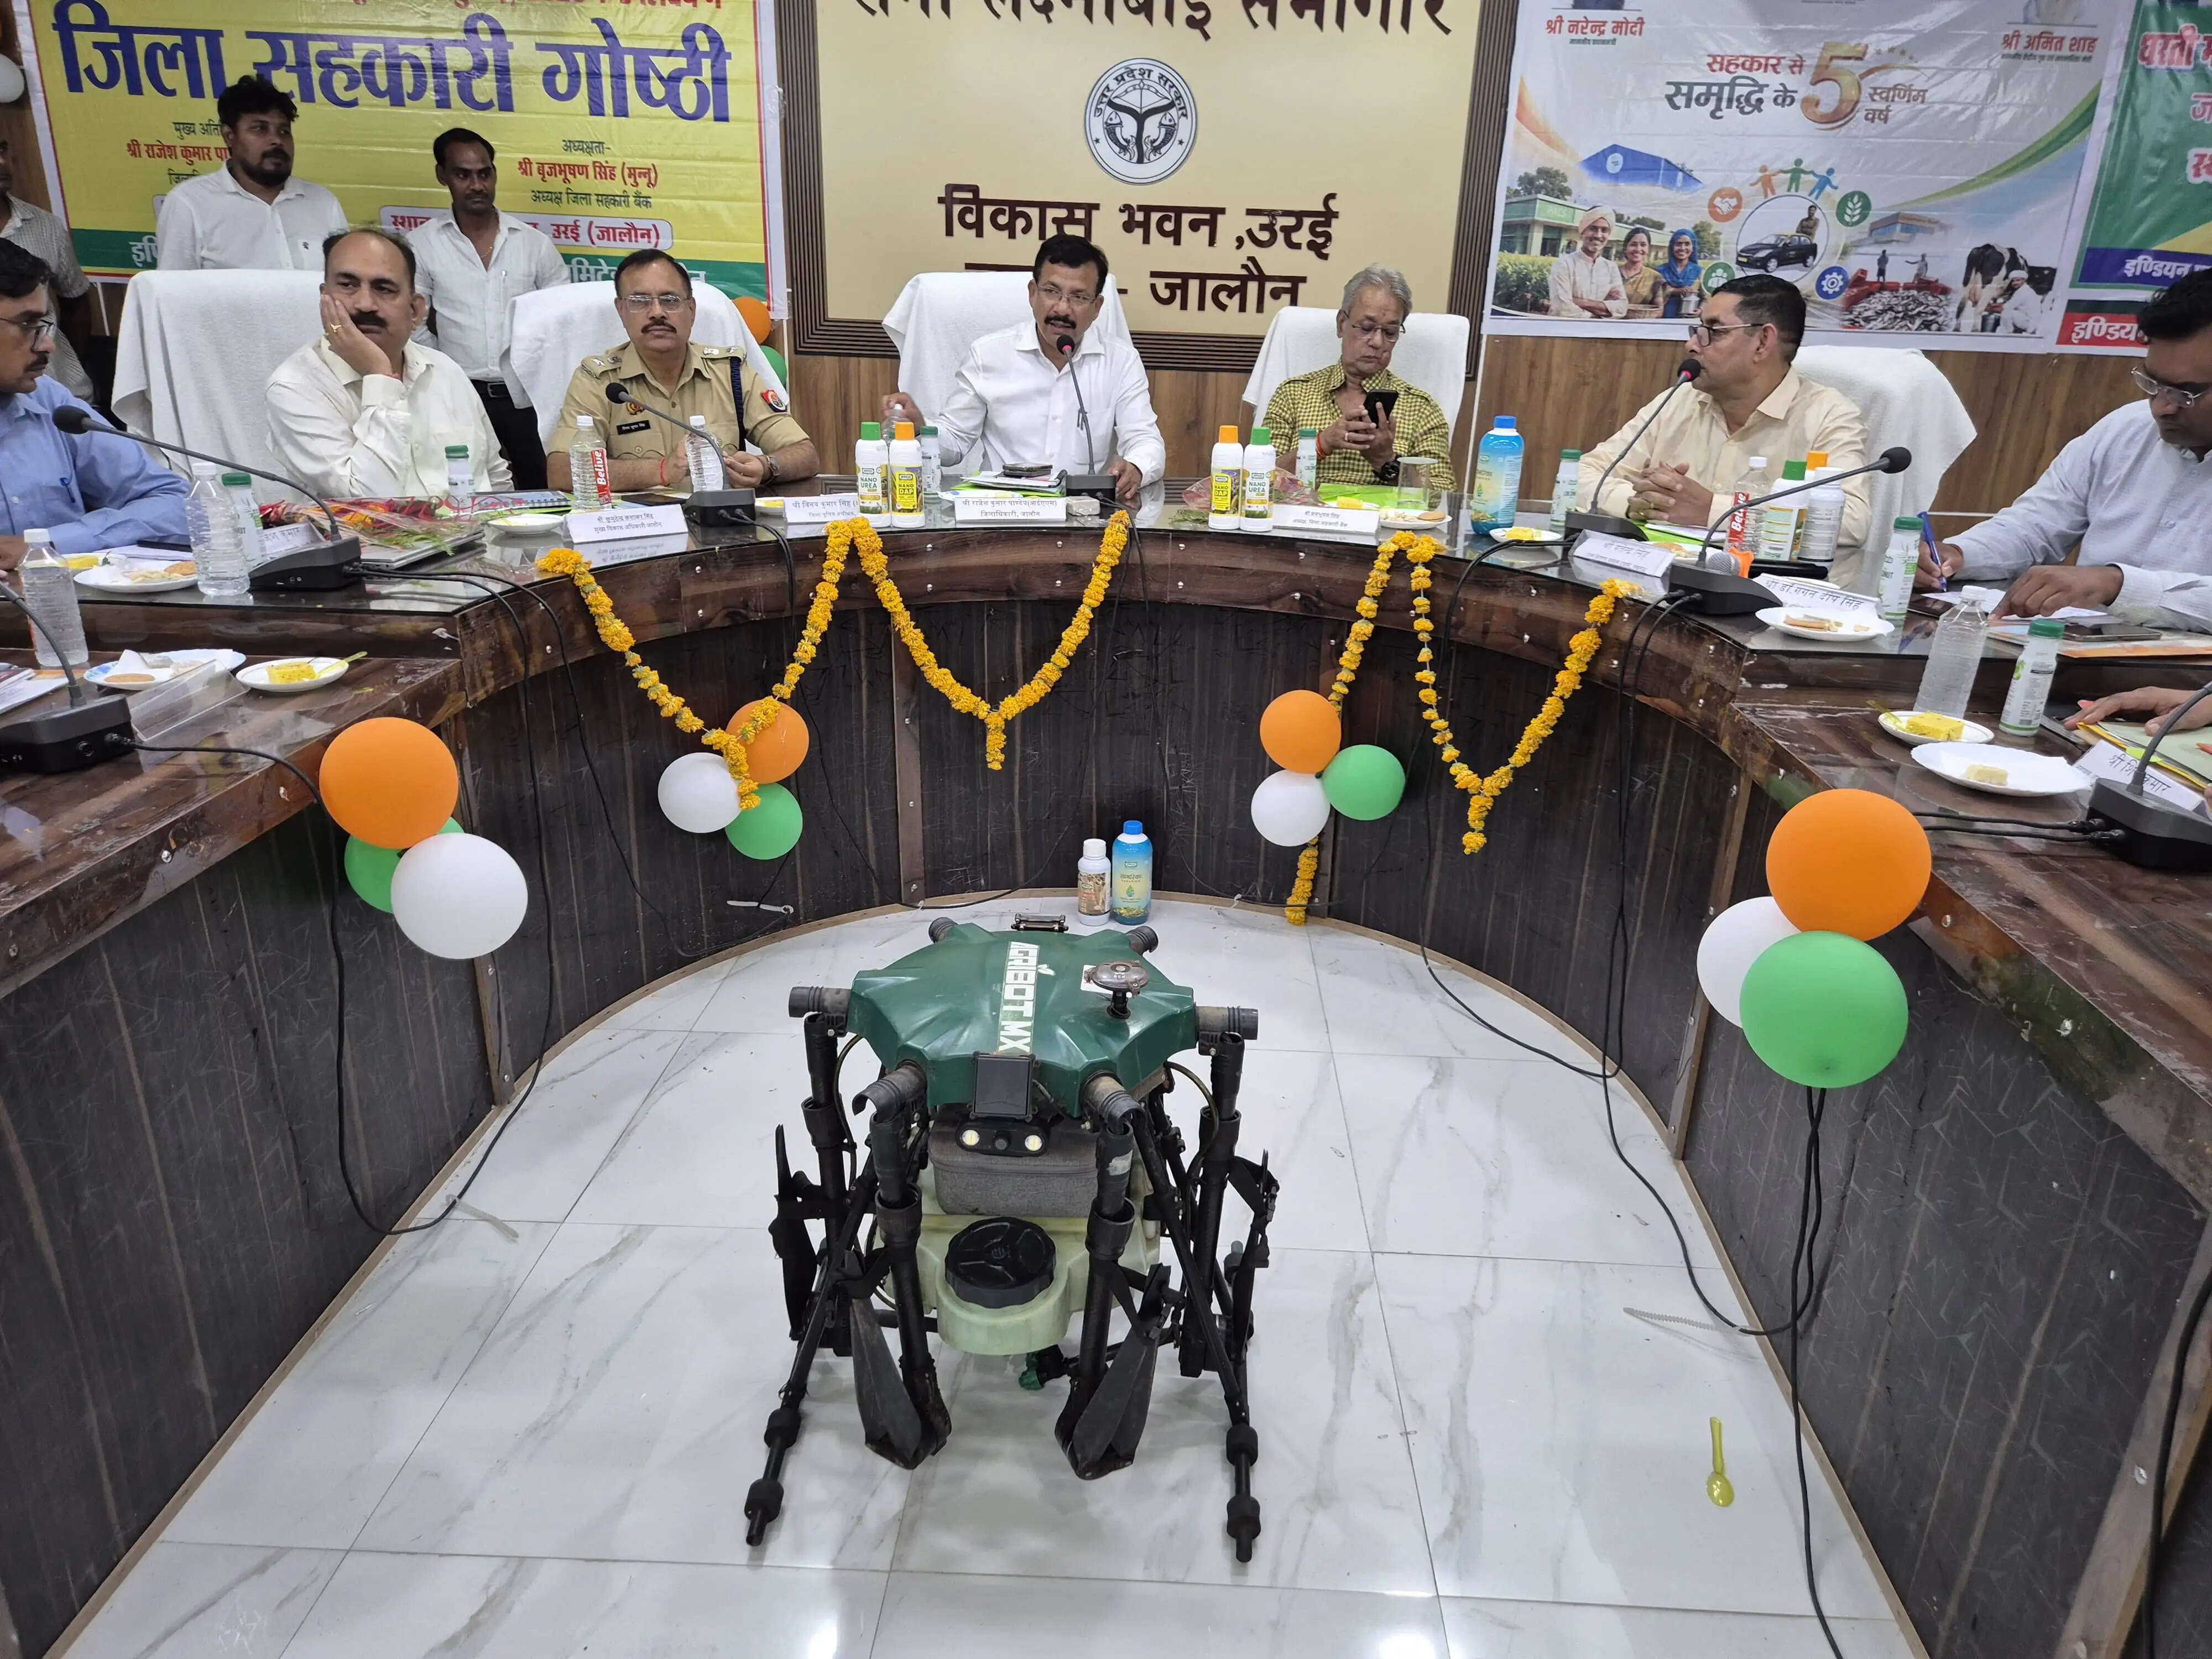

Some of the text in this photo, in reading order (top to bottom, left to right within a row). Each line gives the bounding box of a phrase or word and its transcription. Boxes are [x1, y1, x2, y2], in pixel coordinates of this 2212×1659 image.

[1546, 15, 1645, 36] श्री नरेन्द्र मोदी
[2001, 30, 2099, 53] श्री अमित शाह
[53, 0, 732, 122] जिला सहकारी गोष्ठी
[1707, 54, 1806, 75] सहकार से
[1094, 67, 1188, 119] उत्तर प्रदेश सरकार
[1801, 41, 1869, 124] 5
[1868, 83, 1928, 104] स्वर्णिम
[1665, 75, 1798, 119] समृद्धि के
[1864, 105, 1893, 124] वर्ष
[172, 122, 196, 140] मुख्य
[126, 139, 142, 158] श्री
[144, 139, 178, 160] राजेश
[180, 145, 212, 166] कुमार
[518, 157, 533, 177] श्री
[535, 162, 589, 184] बृजभूषण
[592, 160, 617, 181] सिंह
[531, 187, 653, 209] अध्यक्ष जिला सहकारी बैंक
[938, 184, 1100, 243] विकास
[1119, 203, 1226, 247] भवन
[550, 220, 660, 248] उरई (जालौन)
[1150, 255, 1307, 313] जालौन
[2072, 316, 2146, 343] इण्डिय
[839, 499, 851, 507] सिंह
[1841, 597, 1864, 611] सिंह
[2109, 753, 2125, 768] श्री
[998, 941, 1040, 1053] AGRIBOT MX
